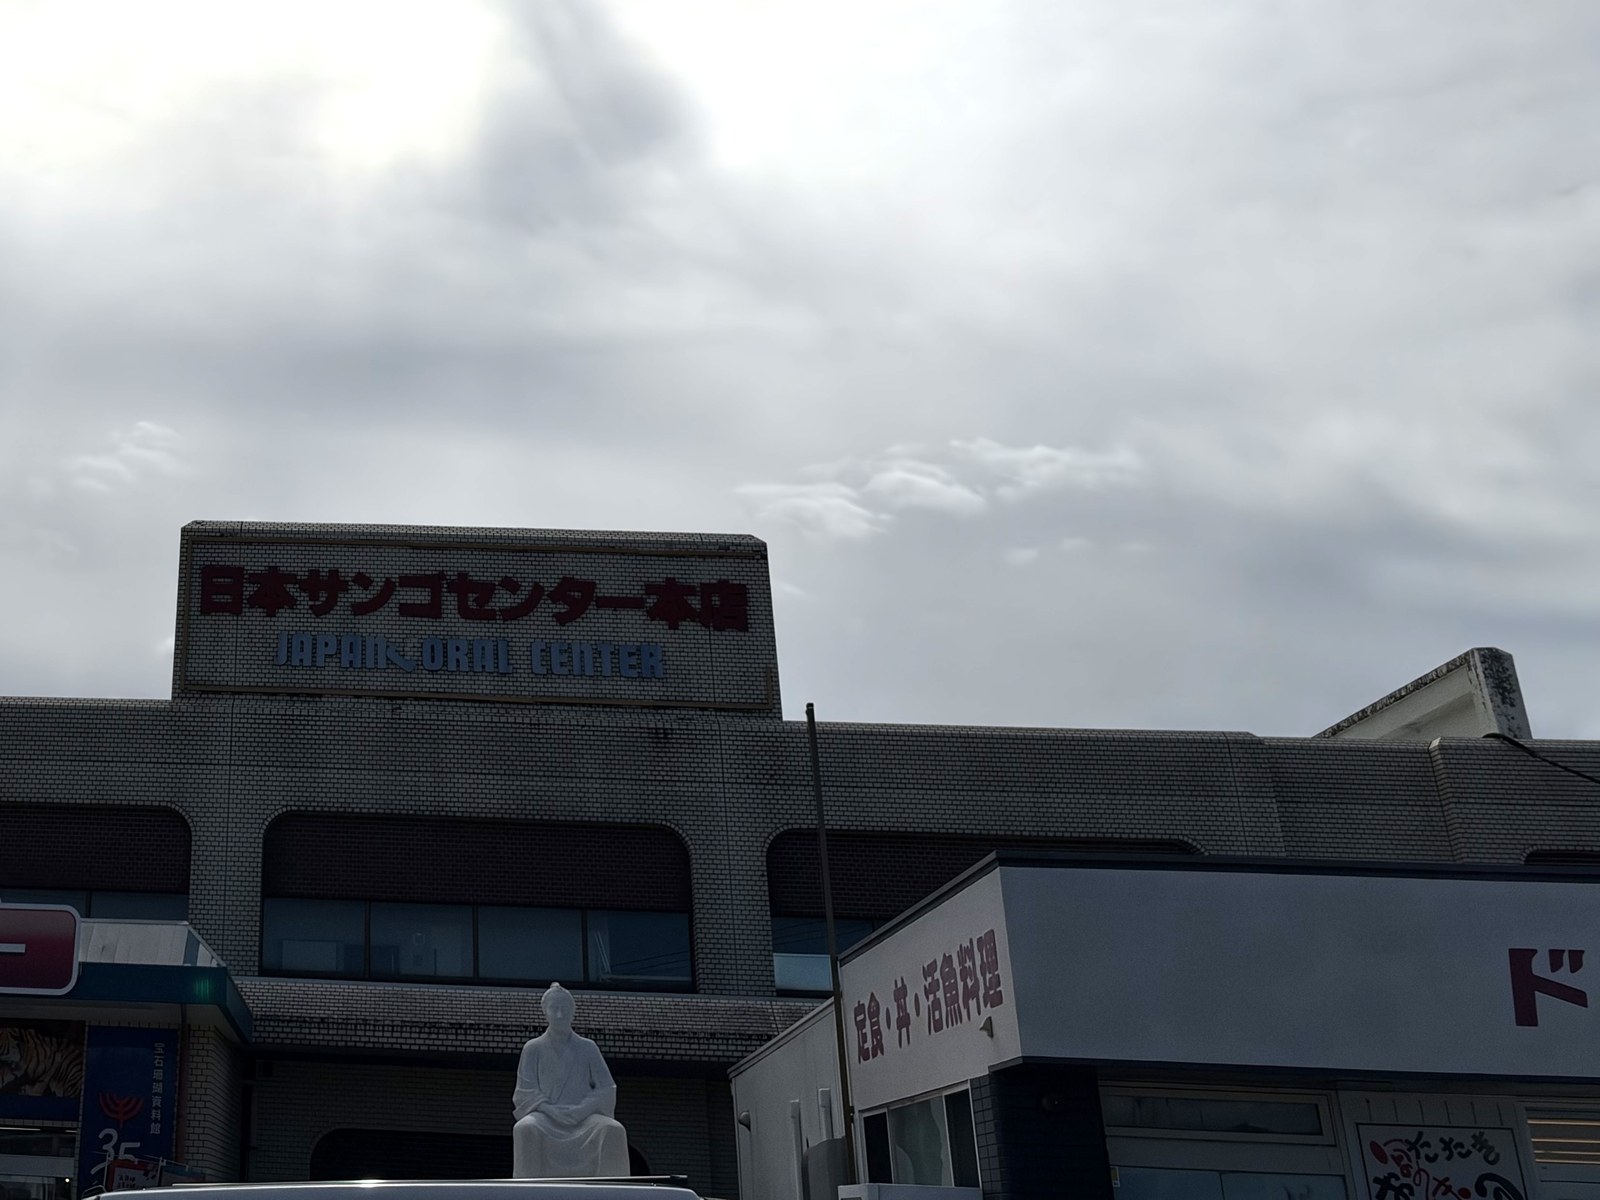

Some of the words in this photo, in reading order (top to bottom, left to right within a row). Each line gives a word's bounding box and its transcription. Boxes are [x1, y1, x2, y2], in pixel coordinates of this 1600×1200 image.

[200, 565, 750, 632] 日本サンゴセンター本店
[274, 631, 387, 669] JAPAN
[531, 639, 665, 679] CENTER
[853, 929, 1003, 1064] 定食・丼・活魚料理
[1508, 948, 1588, 1027] ド
[1404, 1131, 1500, 1166] たたき
